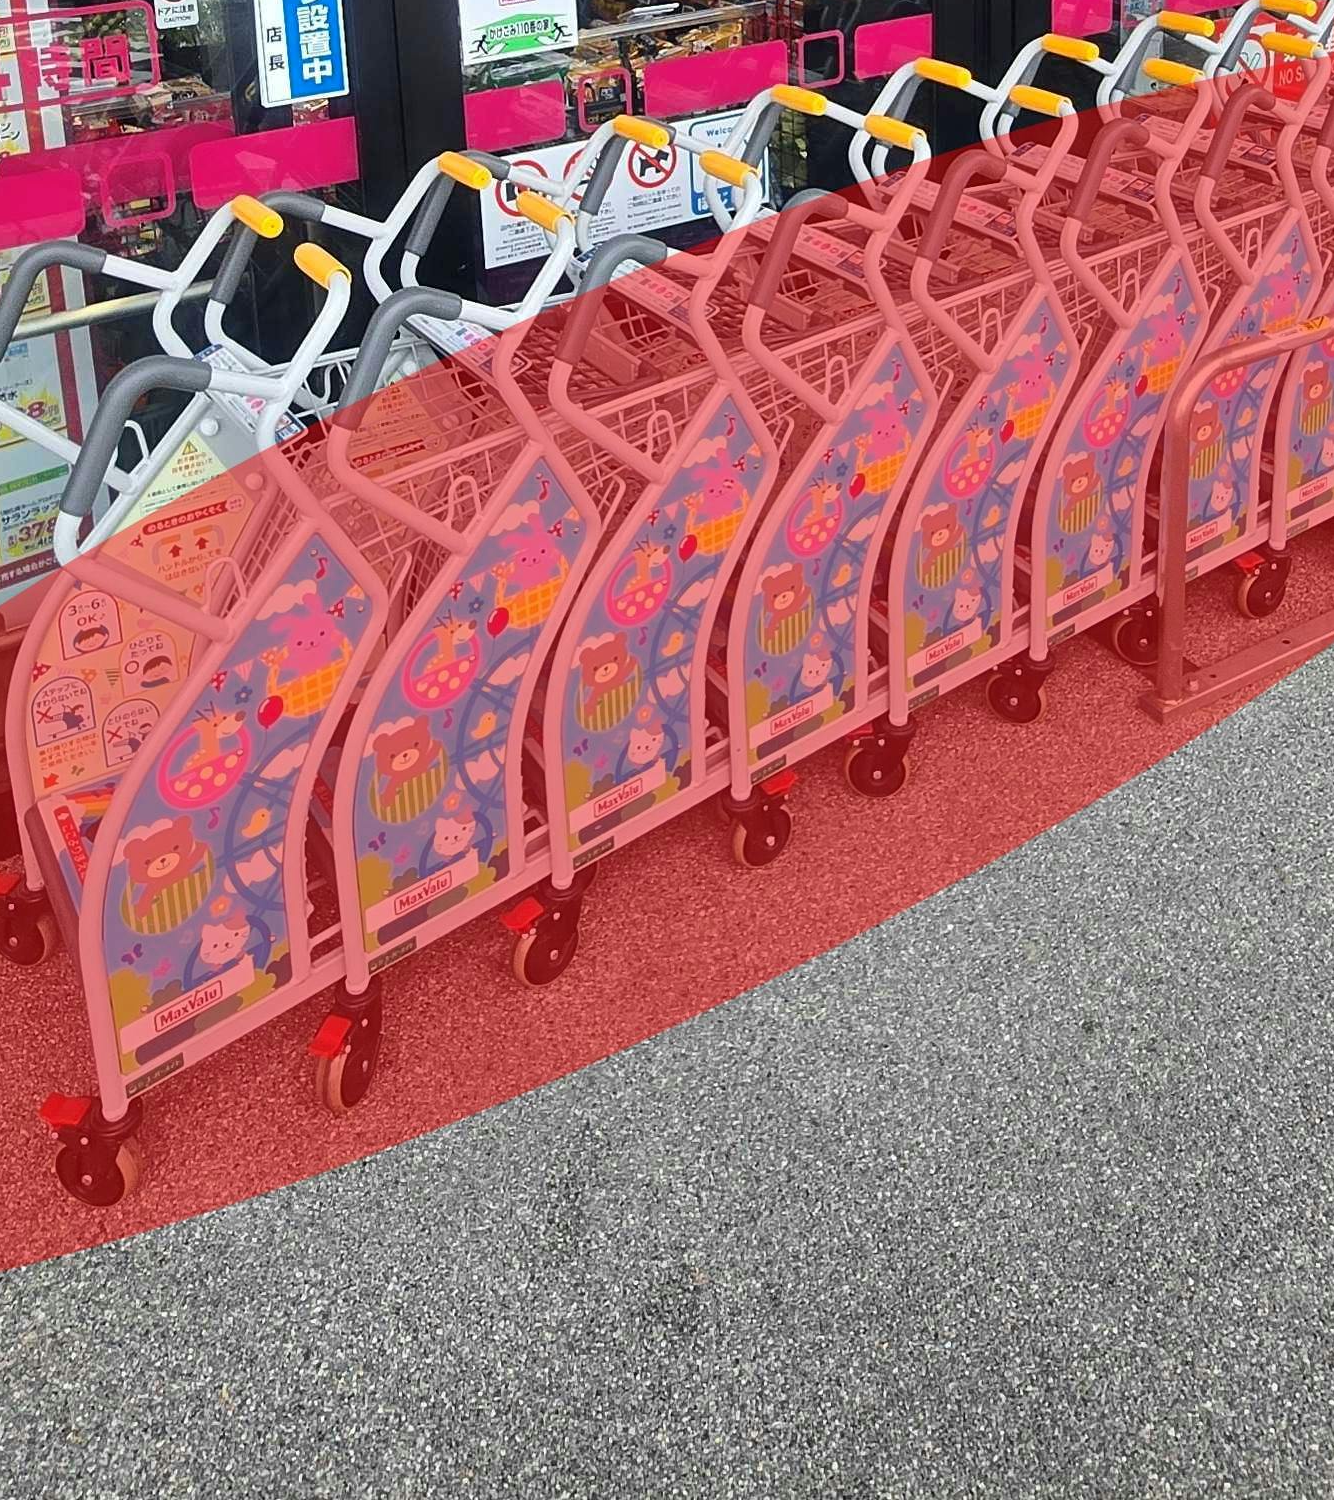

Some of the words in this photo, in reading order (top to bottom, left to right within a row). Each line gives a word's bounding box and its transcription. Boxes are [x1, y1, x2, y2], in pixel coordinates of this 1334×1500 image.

[267, 25, 285, 72] 店長
[706, 127, 734, 139] Welco
[596, 781, 642, 813] MaxValu
[396, 876, 450, 911] MaxValu
[158, 986, 219, 1027] MaxValu
